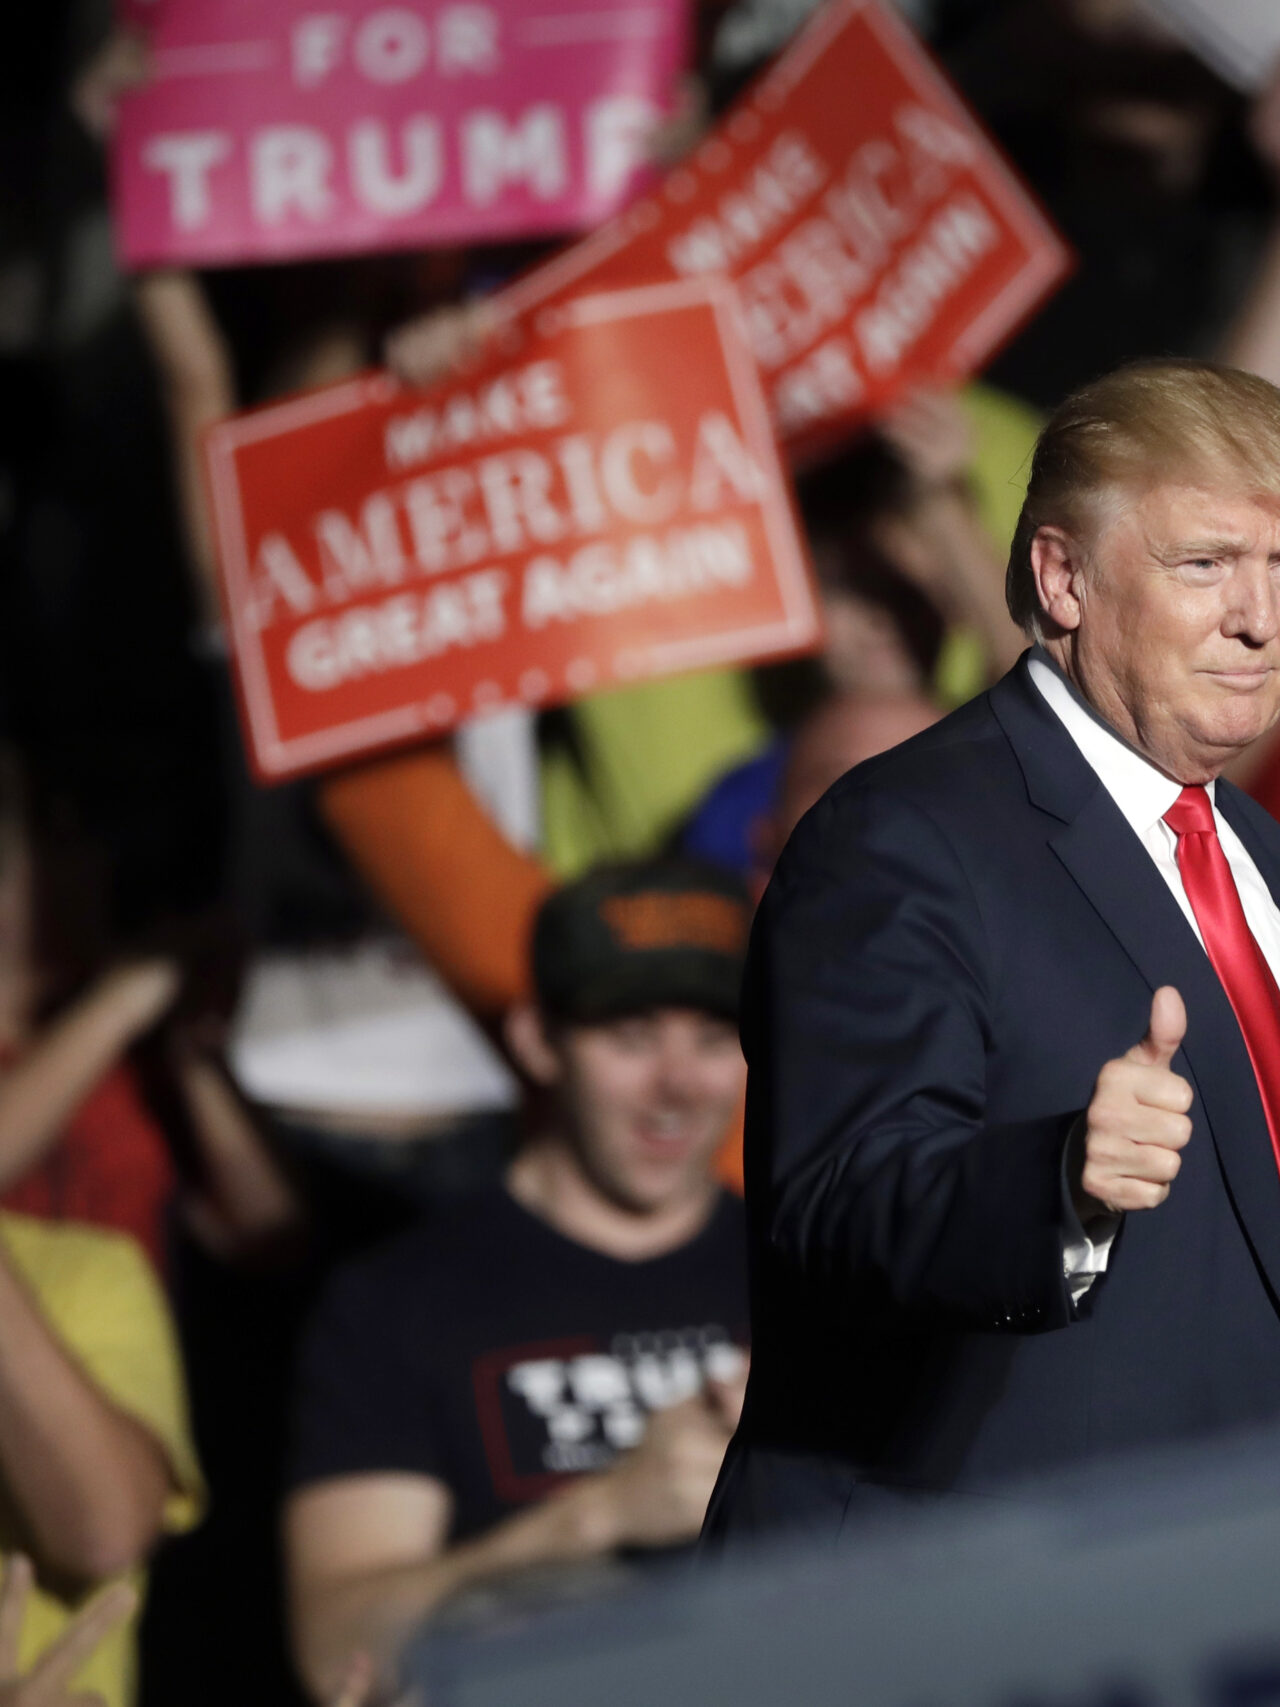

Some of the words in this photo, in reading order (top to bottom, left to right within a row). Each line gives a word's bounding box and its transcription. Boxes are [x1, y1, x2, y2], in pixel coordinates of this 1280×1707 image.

[290, 3, 498, 91] FOR
[382, 357, 571, 468] MAKE
[244, 409, 772, 633] AMERICA
[286, 567, 506, 692] GREAT
[521, 519, 756, 630] AGAIN
